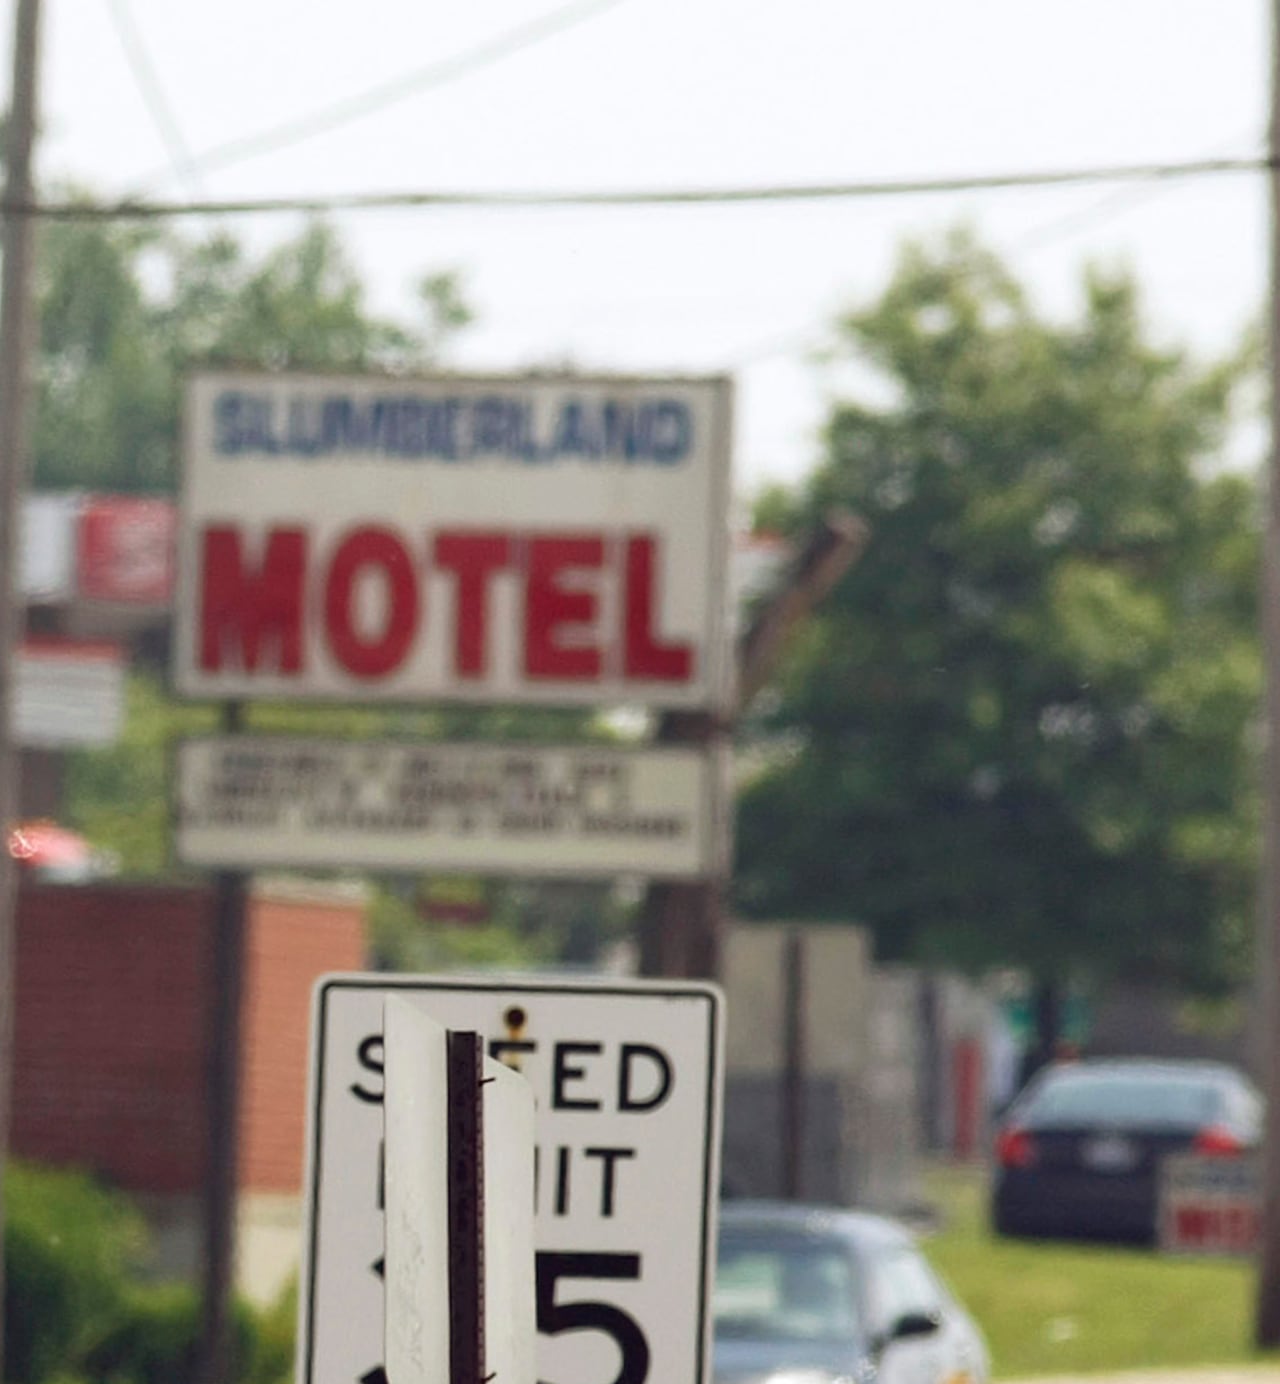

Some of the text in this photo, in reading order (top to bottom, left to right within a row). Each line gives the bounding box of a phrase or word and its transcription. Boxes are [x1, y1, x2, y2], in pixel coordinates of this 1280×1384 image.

[213, 391, 694, 465] SLUMBERLAND
[199, 522, 696, 684] MOTEL
[350, 1035, 674, 1114] SED
